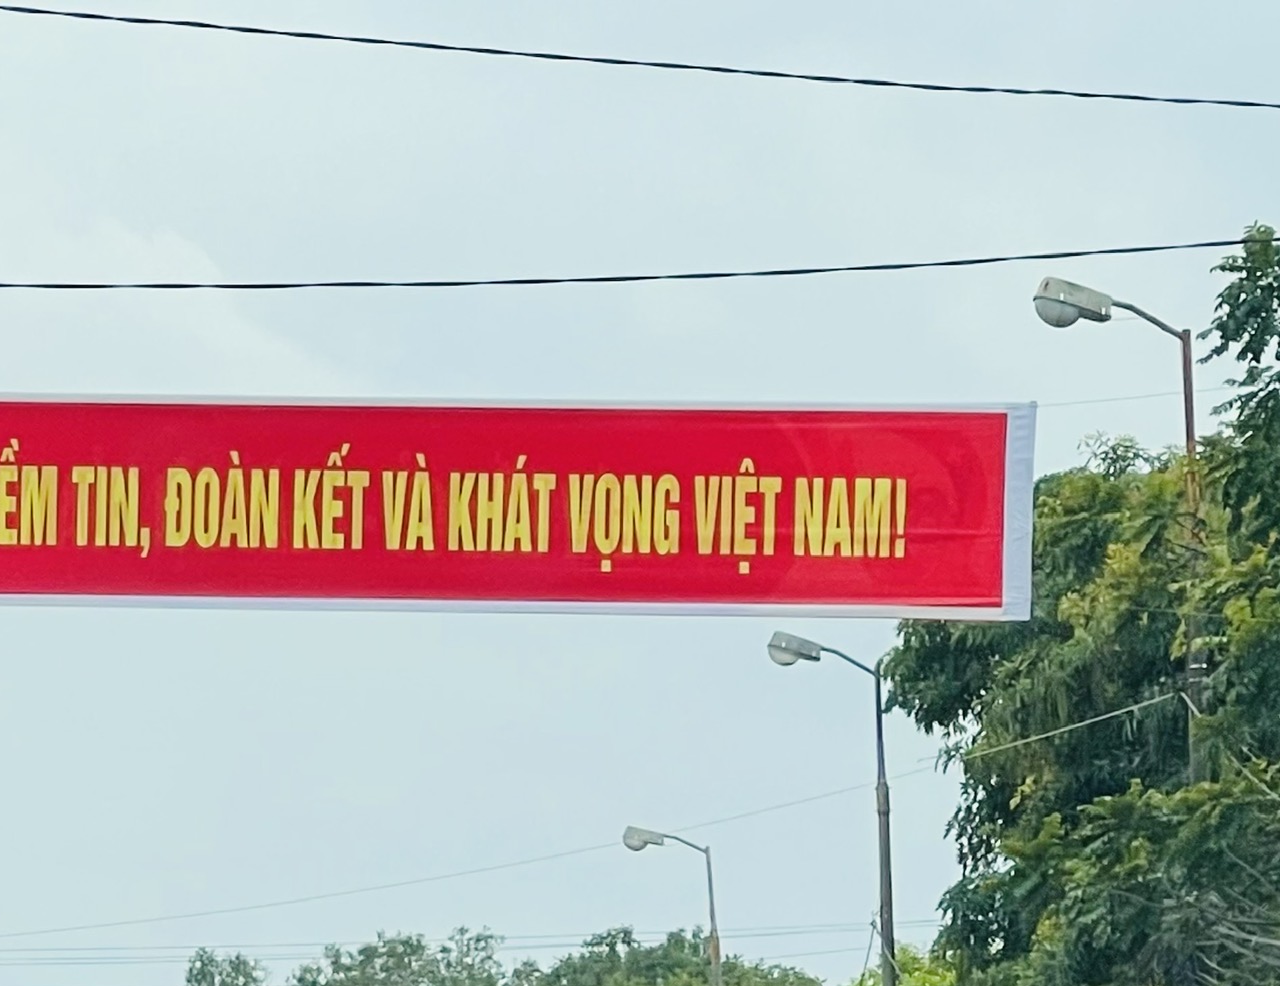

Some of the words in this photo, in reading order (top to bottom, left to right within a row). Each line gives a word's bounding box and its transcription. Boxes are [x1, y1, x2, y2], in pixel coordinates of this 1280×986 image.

[72, 466, 150, 558] TIN,
[164, 451, 279, 548] ĐOÀN
[293, 444, 369, 549] KẾT
[383, 453, 434, 550] VÀ
[448, 455, 556, 552] KHÁT
[569, 474, 680, 572] VỌNG
[695, 458, 782, 574] VIỆT
[794, 477, 906, 558] NAM!
